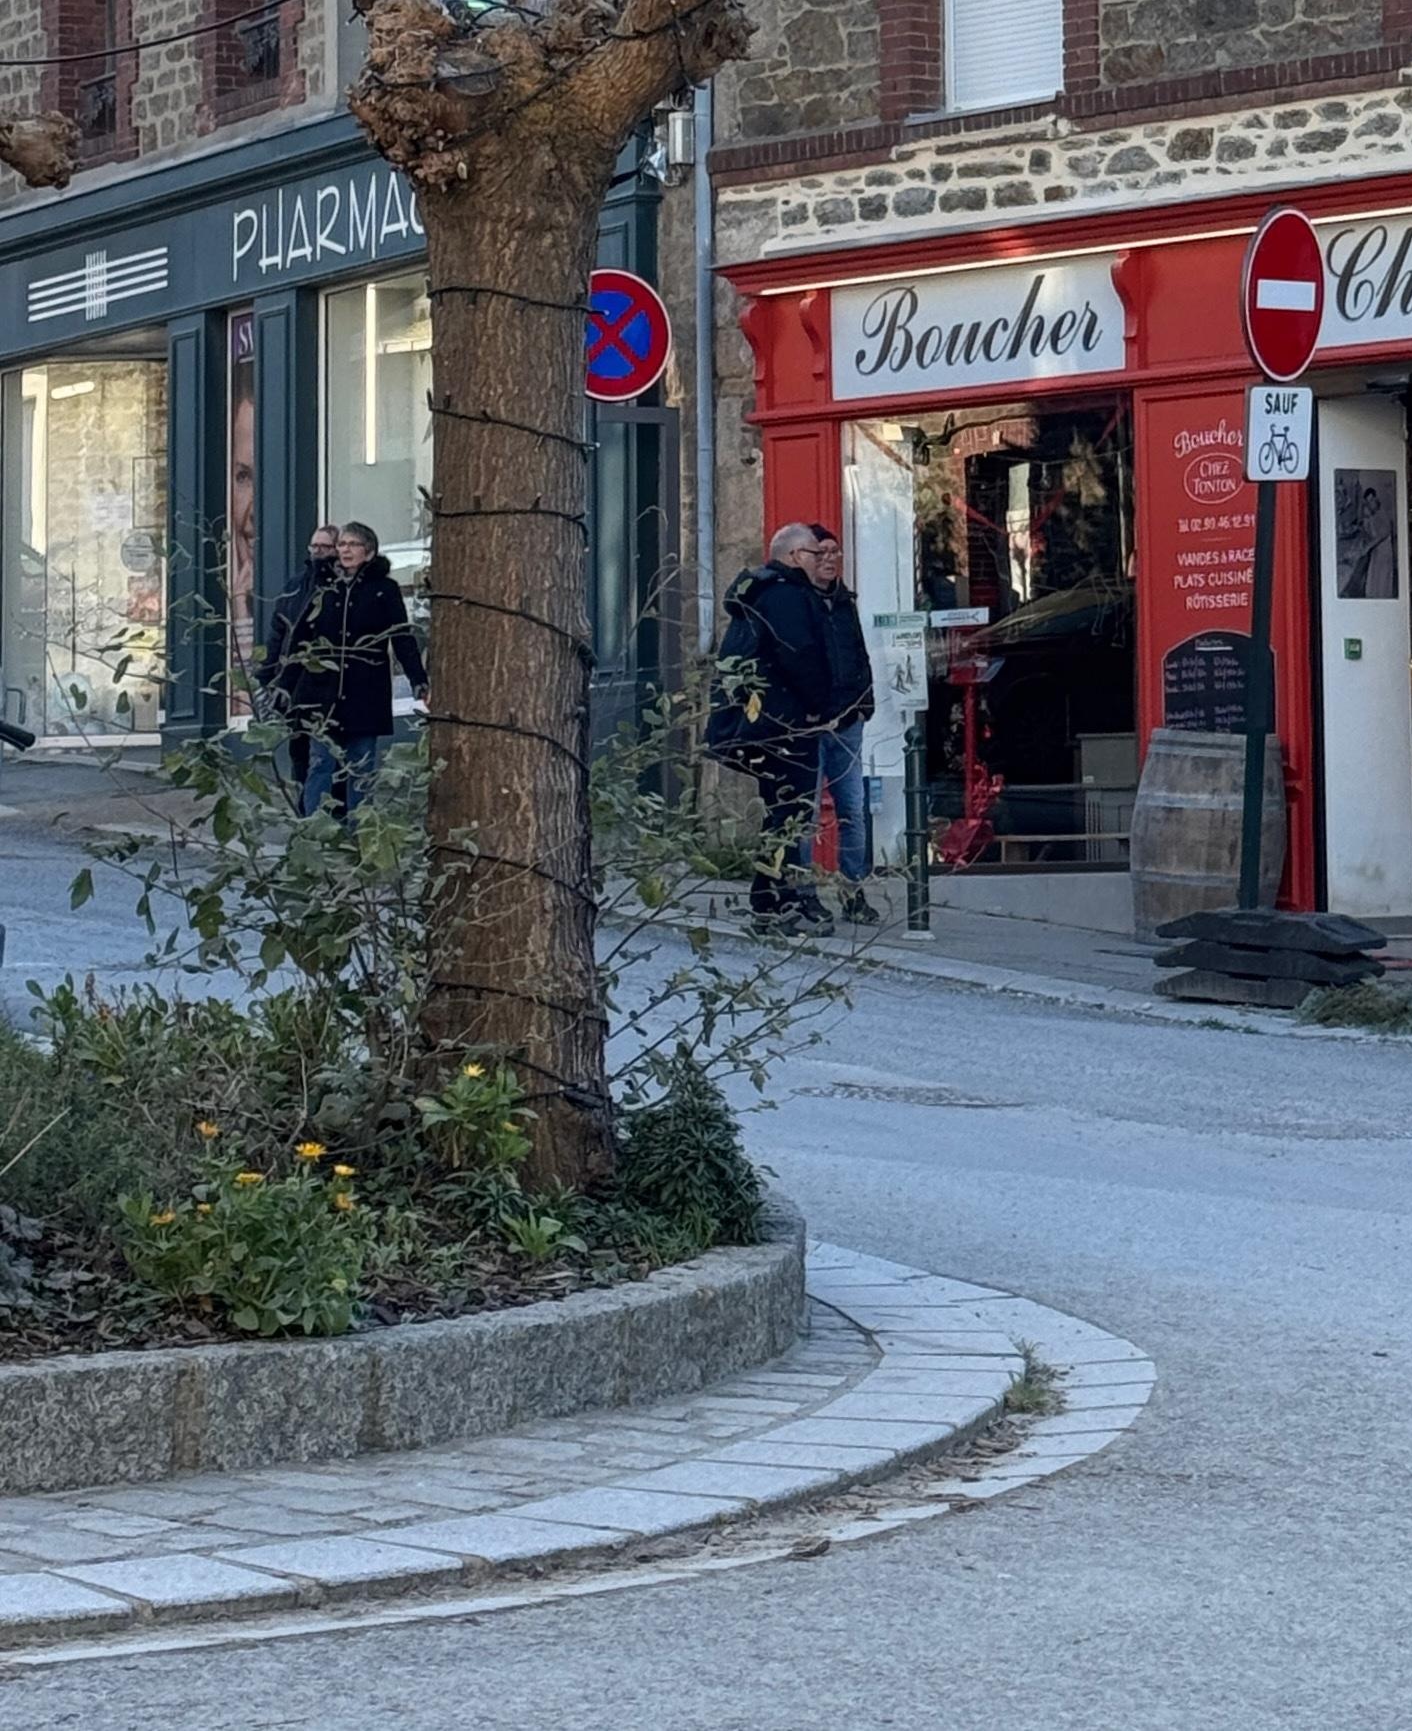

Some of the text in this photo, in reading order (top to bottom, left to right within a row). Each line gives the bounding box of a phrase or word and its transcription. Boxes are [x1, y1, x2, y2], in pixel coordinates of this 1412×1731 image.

[855, 273, 1104, 376] Boucher
[1264, 392, 1300, 415] SAUF
[1191, 476, 1237, 496] TONTON
[1177, 550, 1220, 567] VIANDES
[1174, 573, 1206, 589] PLATS
